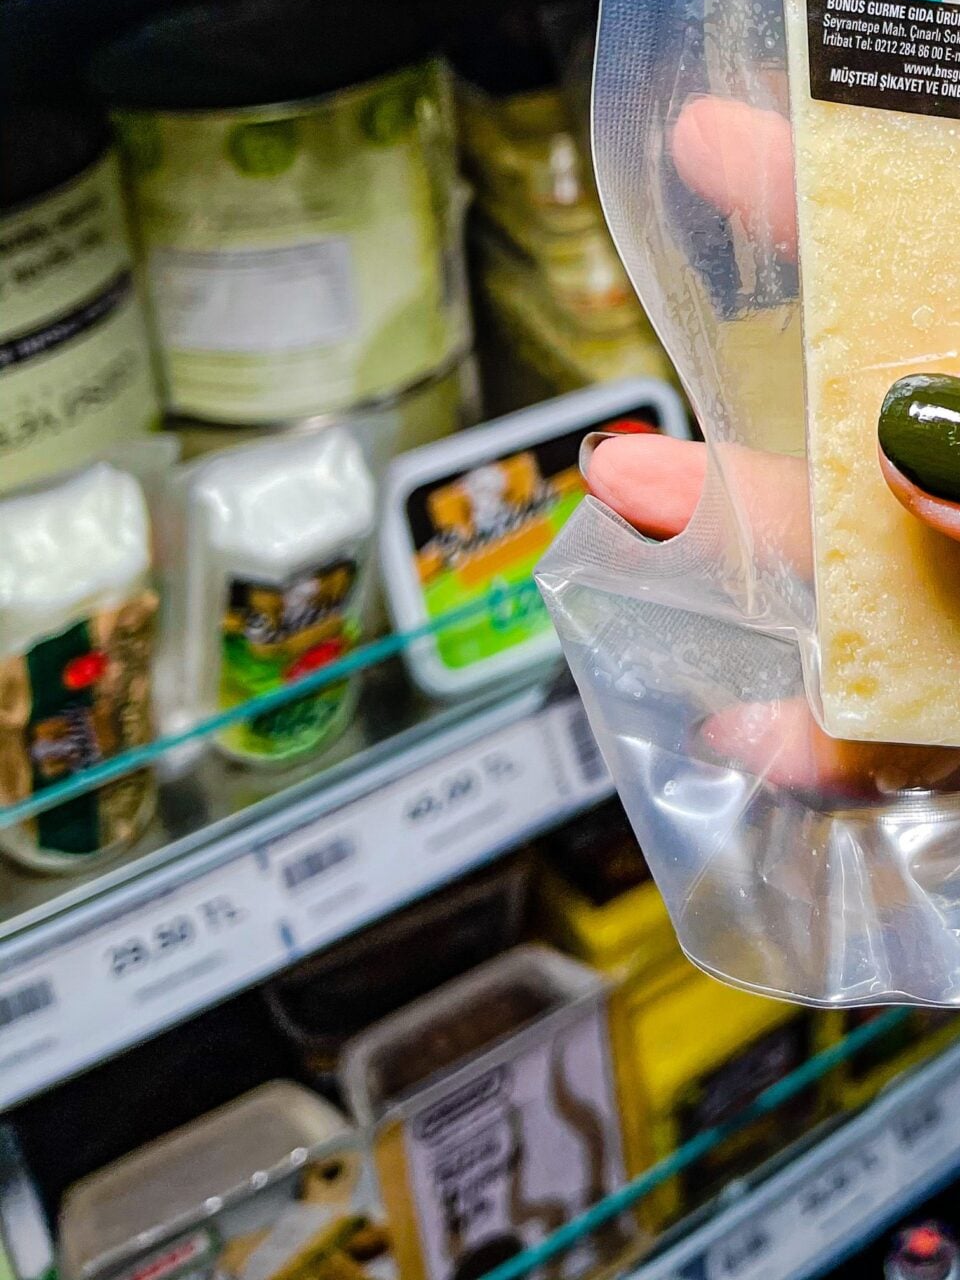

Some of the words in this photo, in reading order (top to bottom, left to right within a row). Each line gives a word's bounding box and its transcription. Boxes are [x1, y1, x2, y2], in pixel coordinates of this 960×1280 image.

[867, 1, 907, 19] GURME
[907, 6, 934, 24] GIDA
[823, 13, 880, 36] Seyrantepe
[882, 21, 907, 38] Mah.
[909, 25, 941, 42] Çınarlı
[823, 29, 853, 48] İrtibat
[855, 35, 873, 51] Tel:
[874, 39, 897, 54] 0212
[899, 42, 916, 56] 284
[917, 44, 930, 58] 86
[931, 46, 944, 60] 00
[830, 66, 879, 88] MÜŞTERİ
[880, 73, 925, 92] ŞİKAYET
[925, 80, 939, 95] VE
